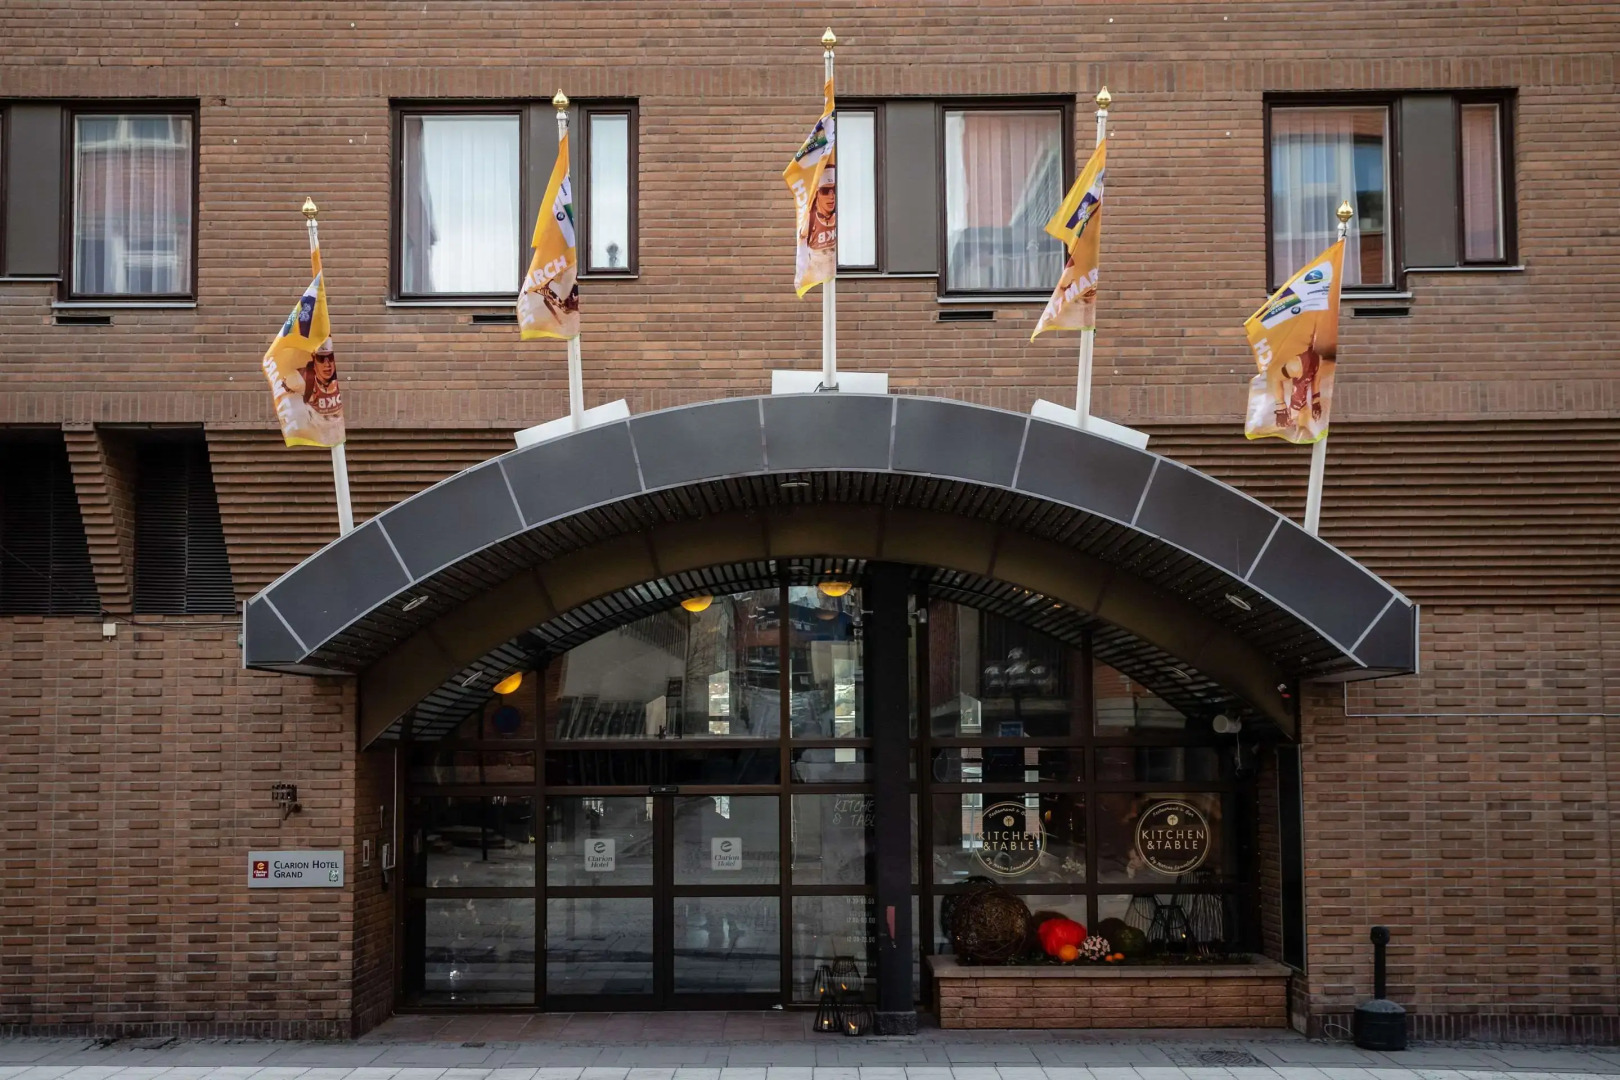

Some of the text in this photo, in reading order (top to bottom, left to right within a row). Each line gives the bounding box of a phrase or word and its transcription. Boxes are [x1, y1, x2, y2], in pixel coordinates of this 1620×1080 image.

[522, 255, 567, 292] ARCH
[977, 831, 1040, 841] KITCHEN
[1142, 830, 1204, 839] KITCHEN
[983, 842, 1034, 850] &TABLE
[1147, 840, 1199, 850] &TABLE
[590, 861, 609, 869] Hotel
